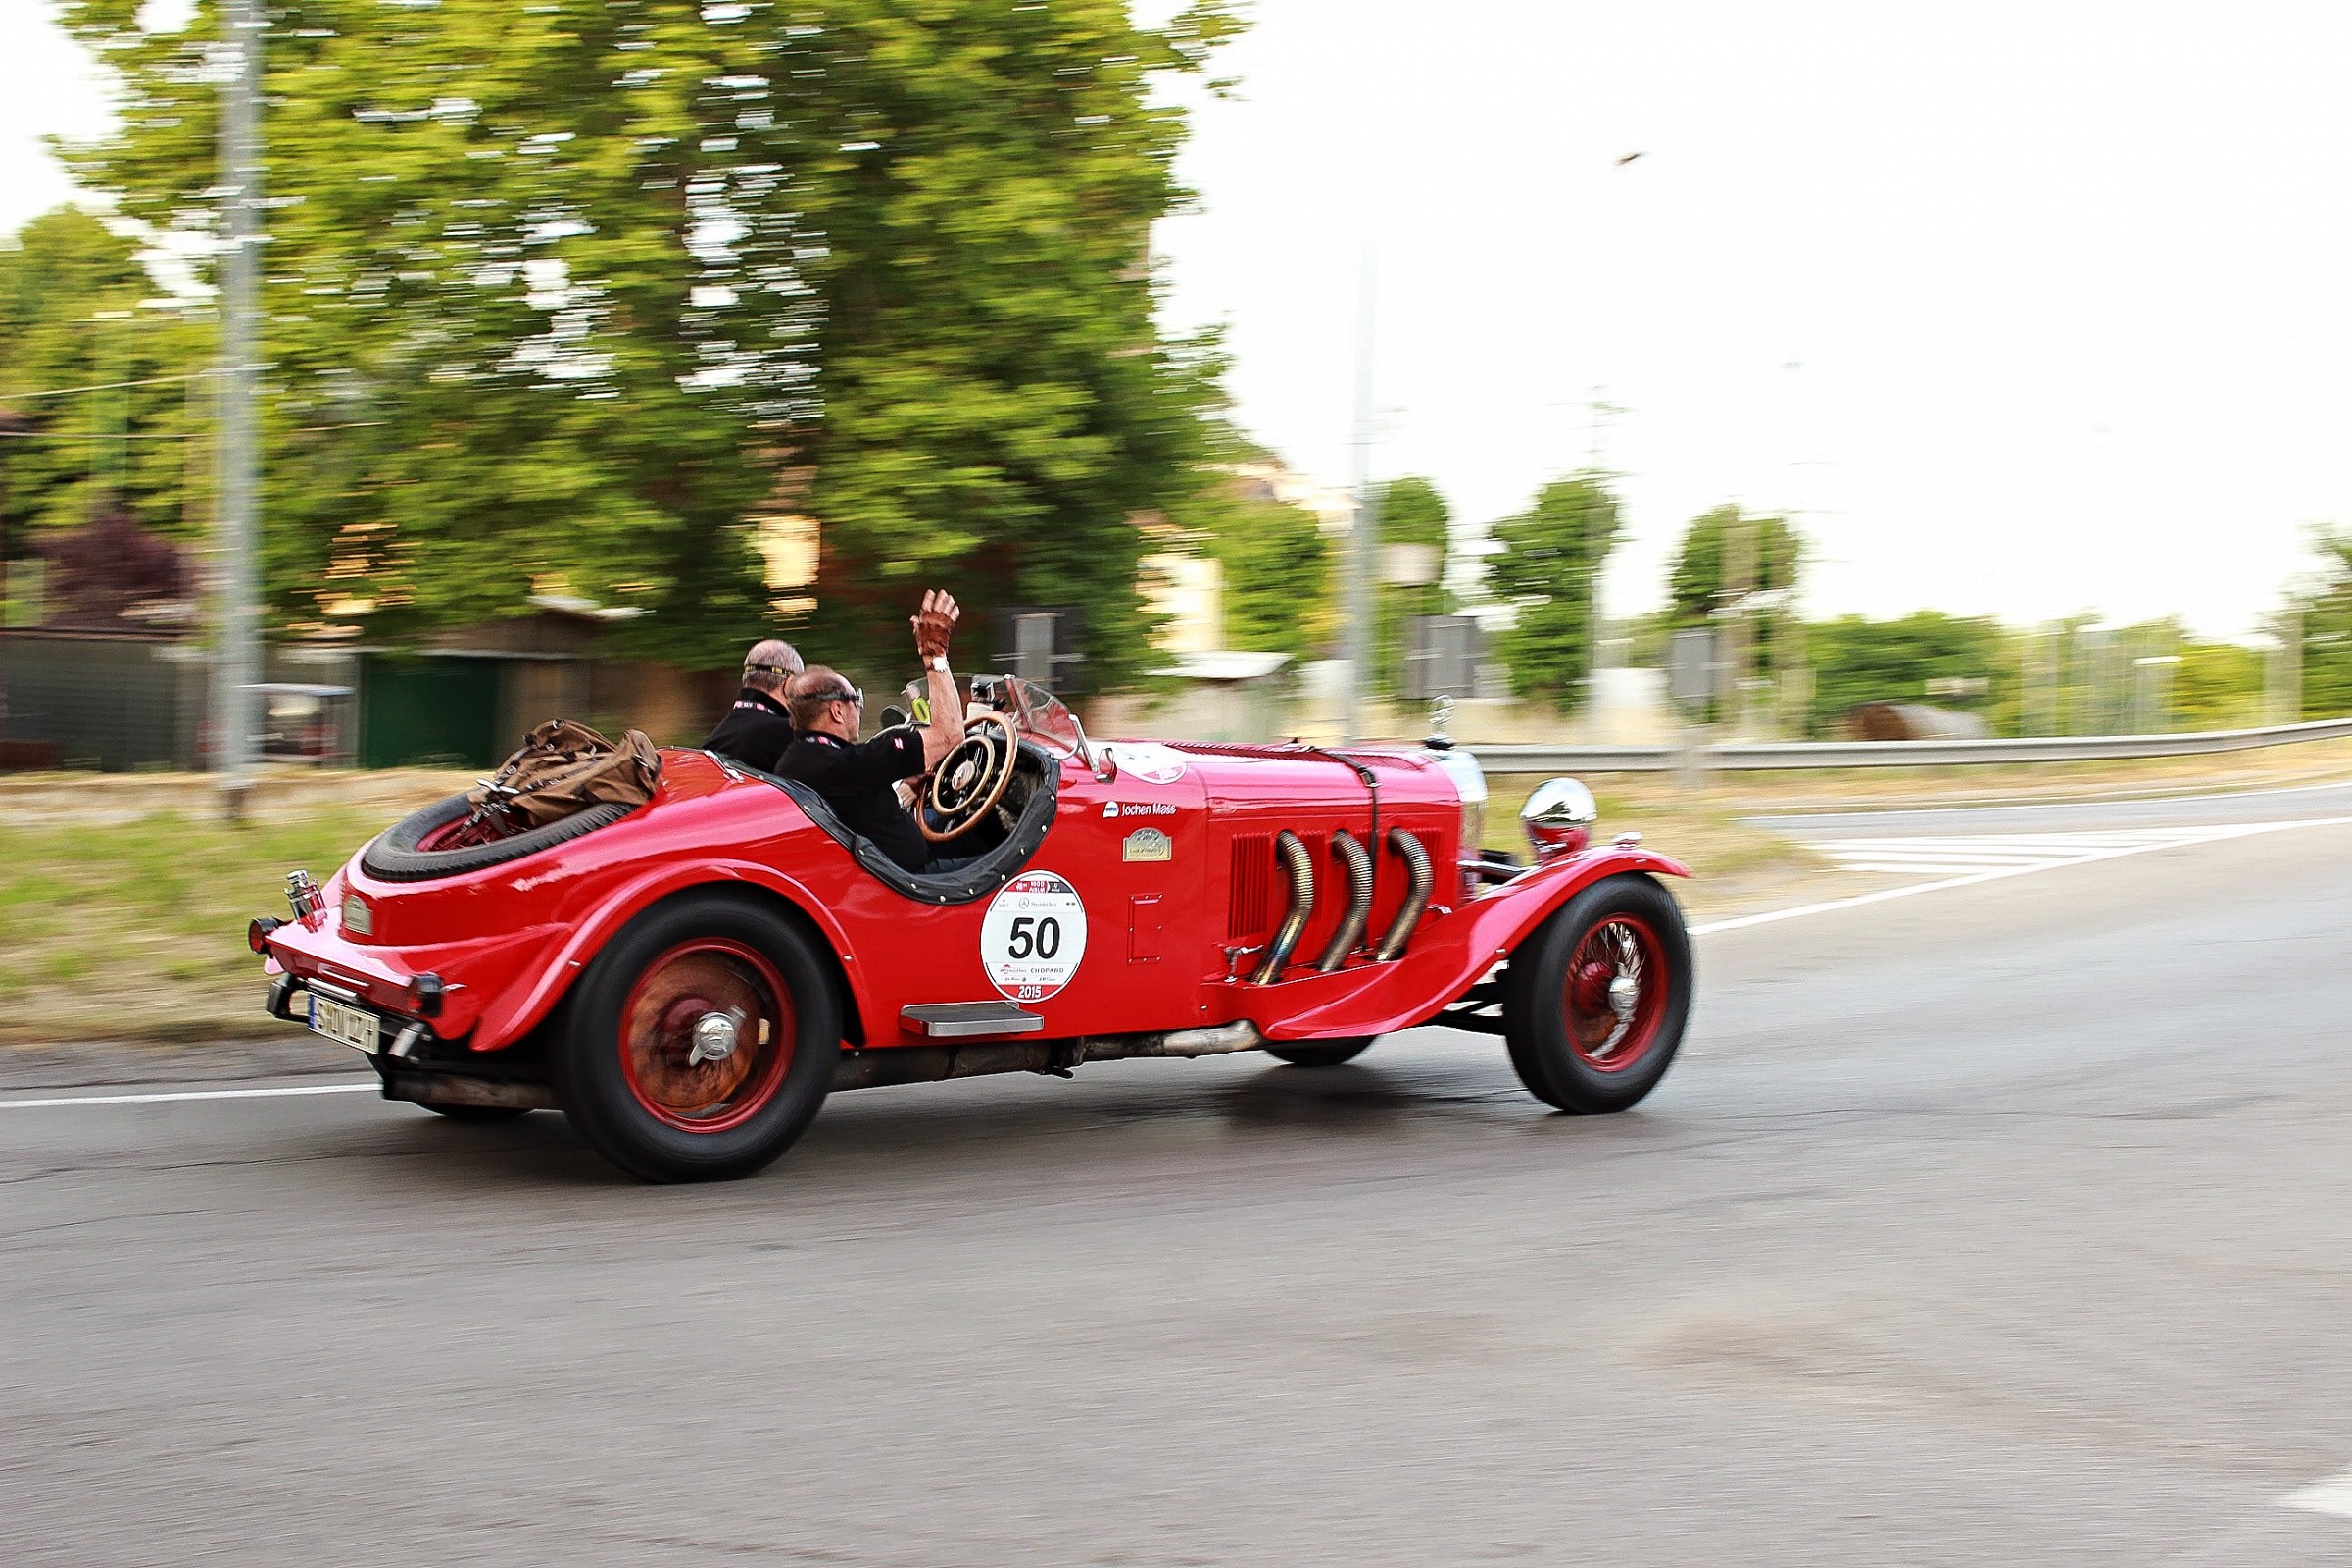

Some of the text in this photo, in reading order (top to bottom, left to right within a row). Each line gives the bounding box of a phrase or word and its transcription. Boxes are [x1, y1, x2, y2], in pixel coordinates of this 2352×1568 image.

[1121, 803, 1177, 817] Jochen Mass
[1008, 916, 1060, 959] 50
[1018, 985, 1042, 998] 2015
